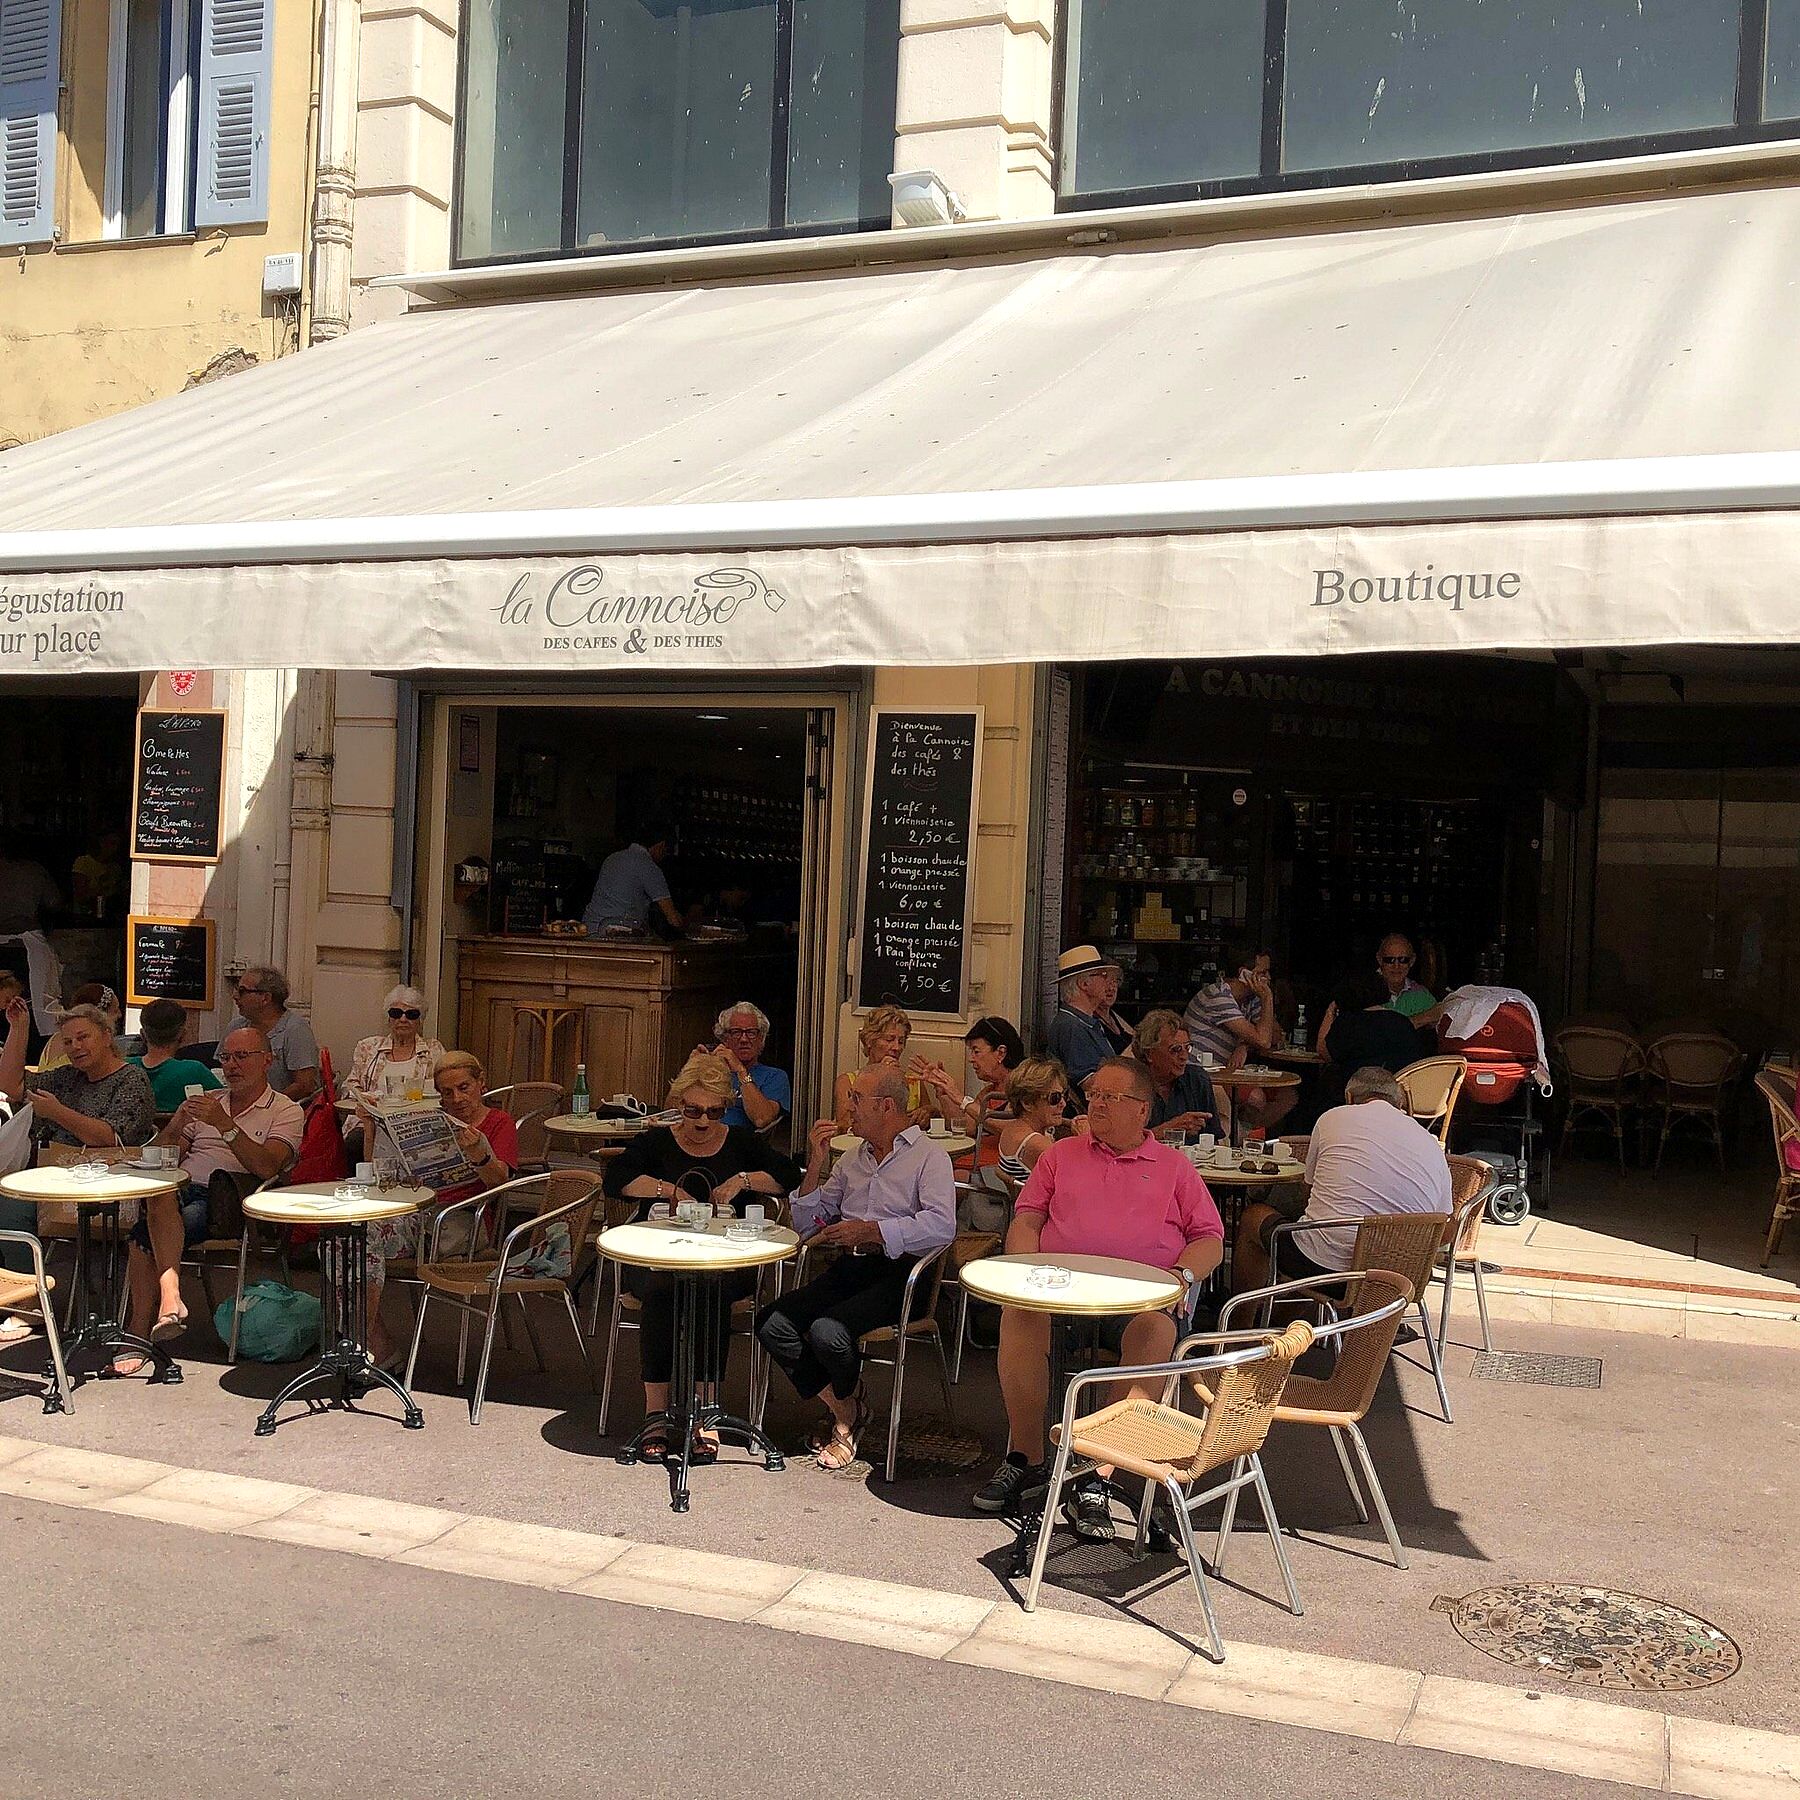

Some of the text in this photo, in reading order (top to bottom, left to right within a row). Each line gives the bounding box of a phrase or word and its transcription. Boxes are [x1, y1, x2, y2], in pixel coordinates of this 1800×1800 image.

[1310, 564, 1521, 611] Boutique
[490, 564, 740, 628] la Cannoise
[33, 623, 101, 662] place
[543, 628, 723, 654] DES CAFES & DES THES
[892, 731, 899, 743] à
[923, 733, 972, 746] Cannoise
[891, 745, 906, 758] des
[953, 747, 962, 760] &
[891, 762, 907, 776] des
[882, 799, 888, 811] 1
[881, 815, 888, 826] 1
[880, 851, 968, 866] 1 boisson chaude
[880, 865, 887, 874] 1
[890, 867, 923, 880] orange
[878, 880, 885, 889] 1
[873, 916, 963, 931] 1 boisson chaude
[873, 932, 880, 946] 1
[885, 935, 921, 950] orange
[874, 945, 882, 958] 1
